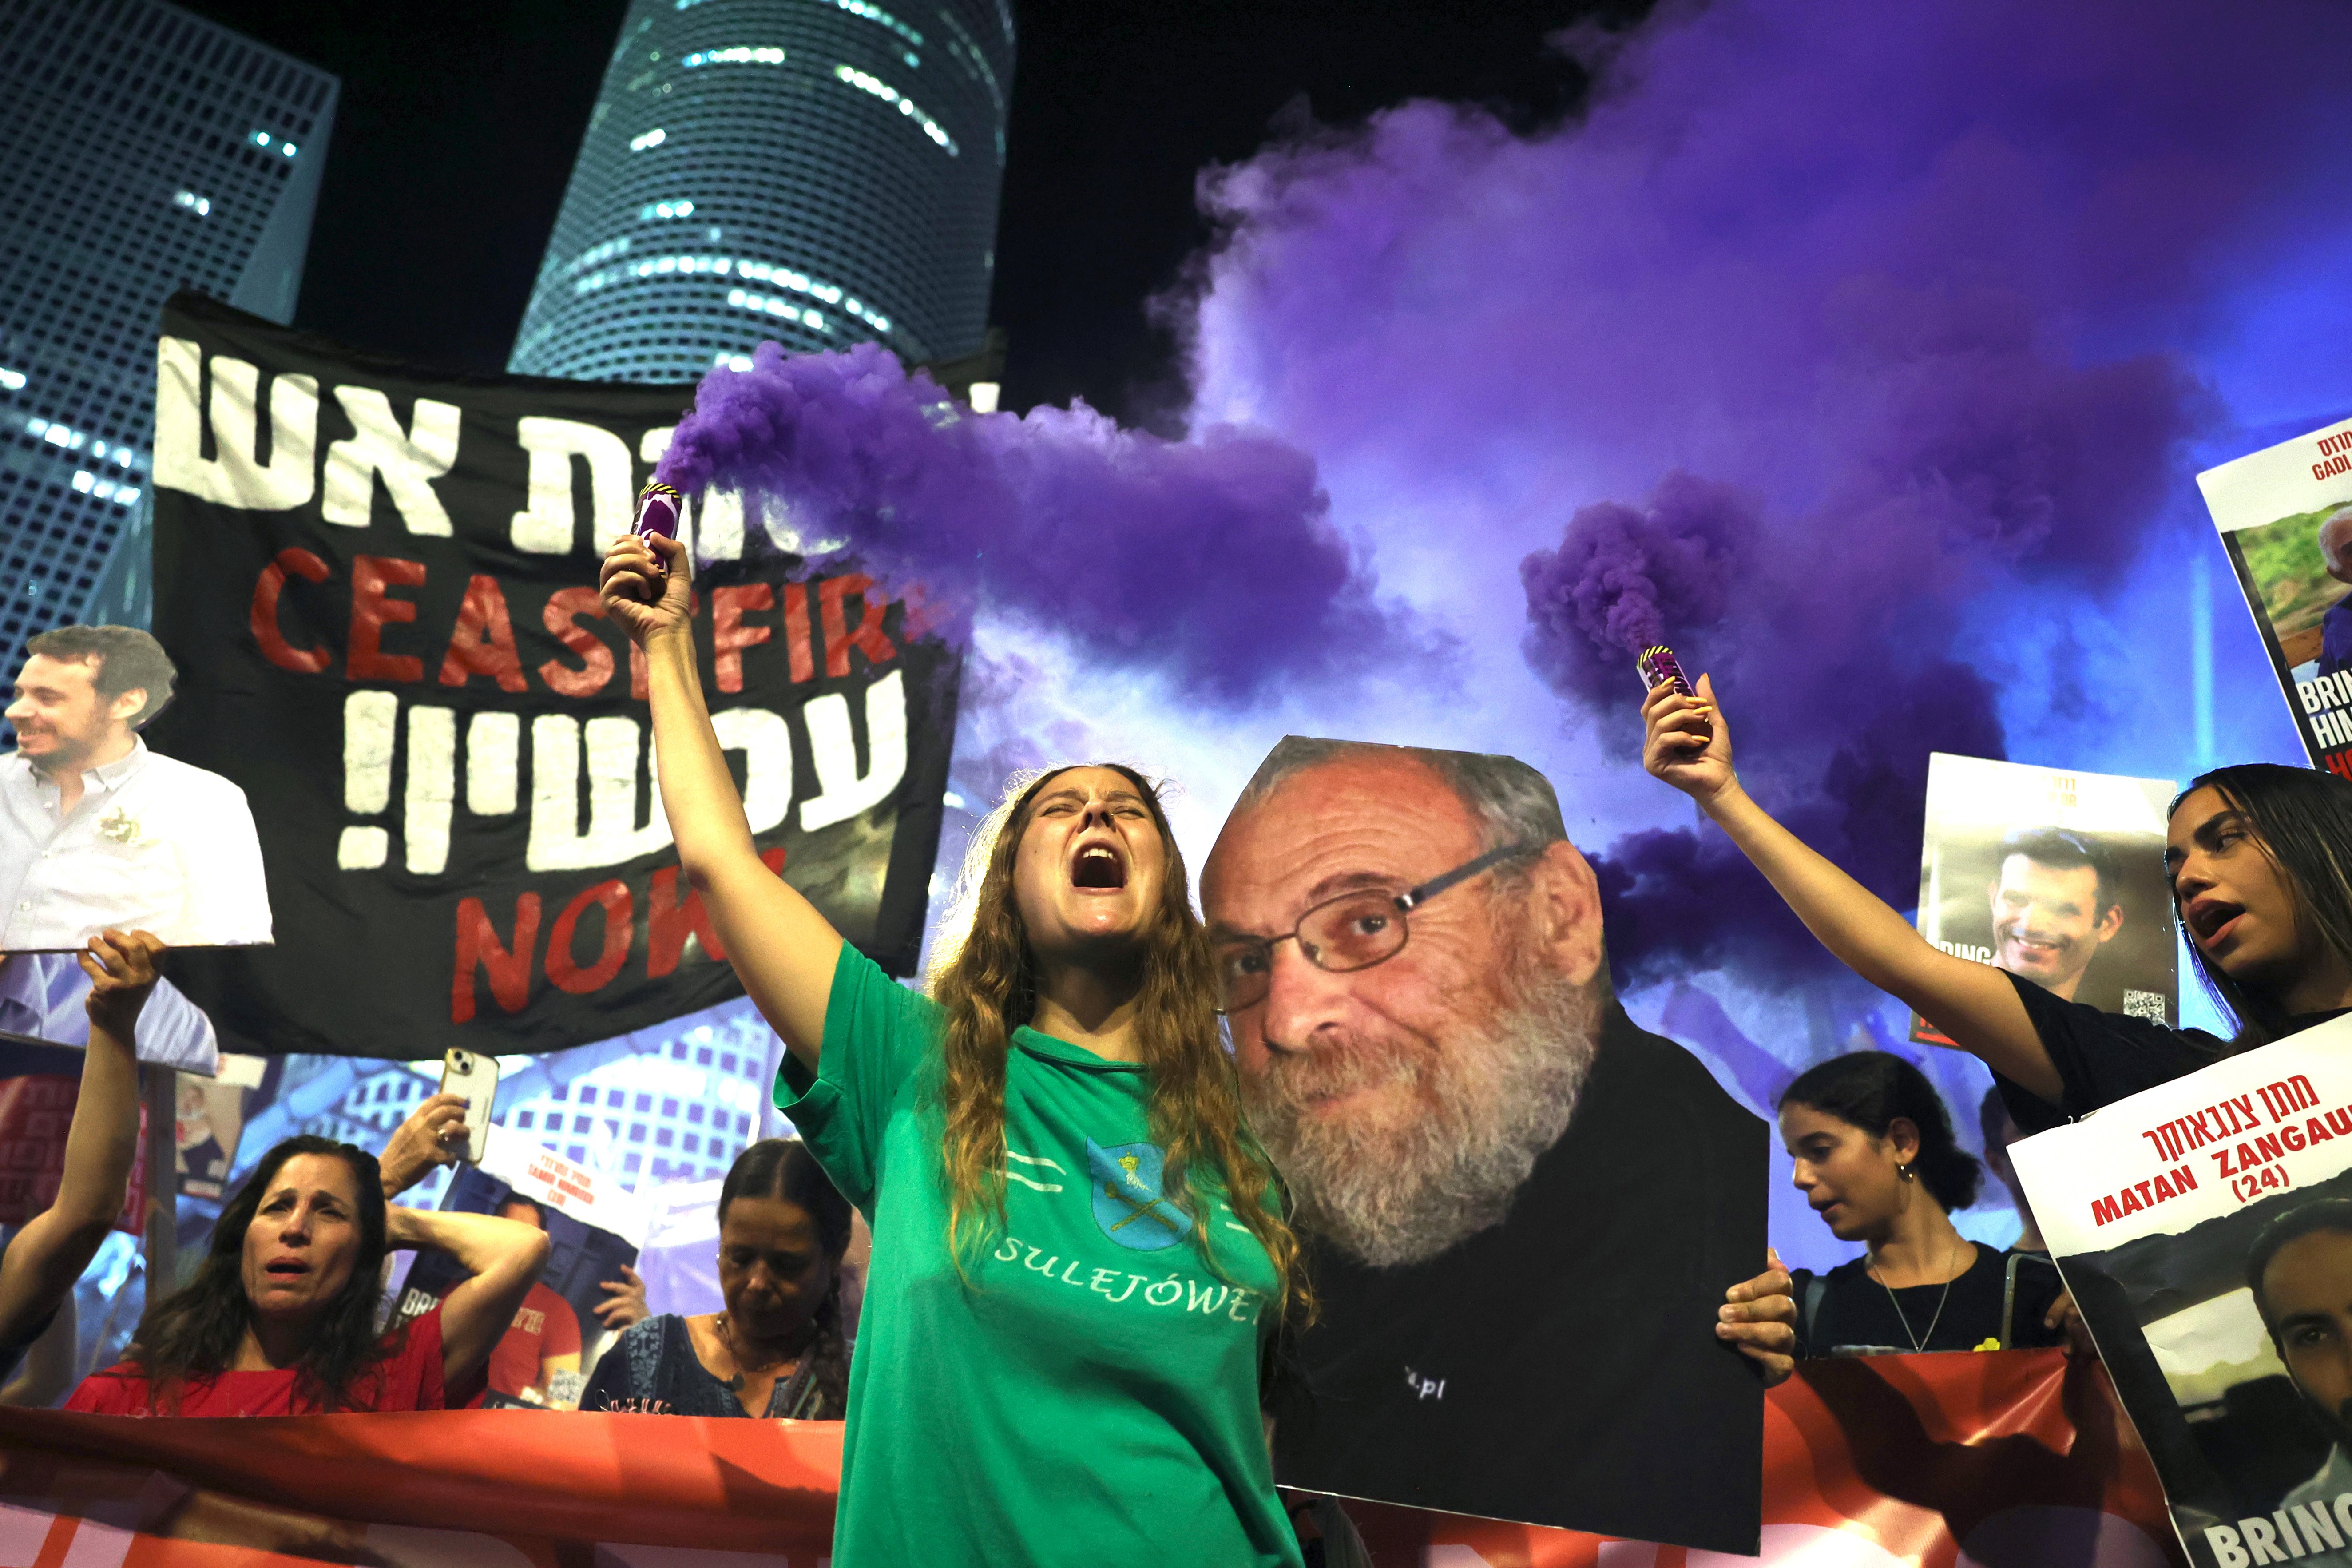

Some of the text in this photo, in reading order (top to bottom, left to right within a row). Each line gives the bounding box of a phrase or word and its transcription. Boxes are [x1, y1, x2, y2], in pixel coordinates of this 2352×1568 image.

[153, 336, 461, 537] אש
[2312, 454, 2352, 480] GADI
[251, 547, 948, 700] CEASFIR
[2142, 1074, 2320, 1162] מתן צנגאוקר
[2091, 1104, 2352, 1227] MATAN ZANGAU
[2232, 1164, 2290, 1203] (24)
[994, 1237, 1265, 1326] SULEJÓWE
